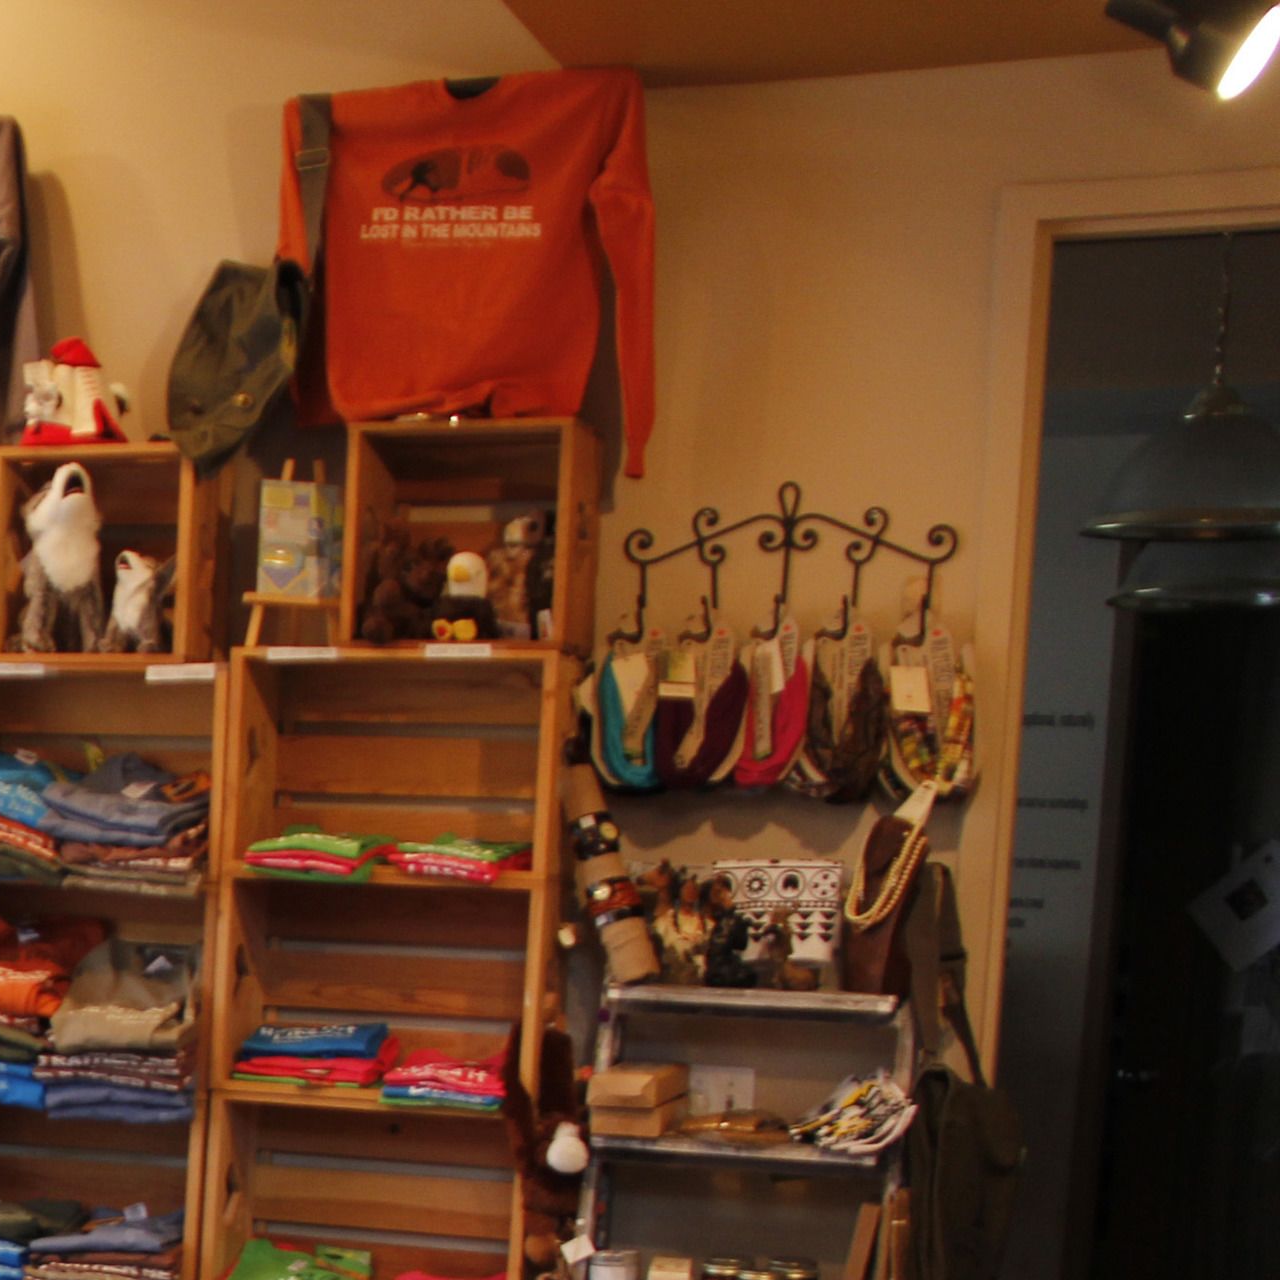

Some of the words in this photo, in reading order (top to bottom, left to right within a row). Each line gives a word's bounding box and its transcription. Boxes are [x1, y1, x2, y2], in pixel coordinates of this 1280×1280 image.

[370, 206, 399, 222] I'D
[403, 205, 497, 221] RATHER
[502, 204, 534, 221] BE
[360, 224, 399, 239] LOST
[401, 224, 417, 238] IN
[421, 223, 449, 238] THE
[452, 221, 542, 238] MOUNTAINS
